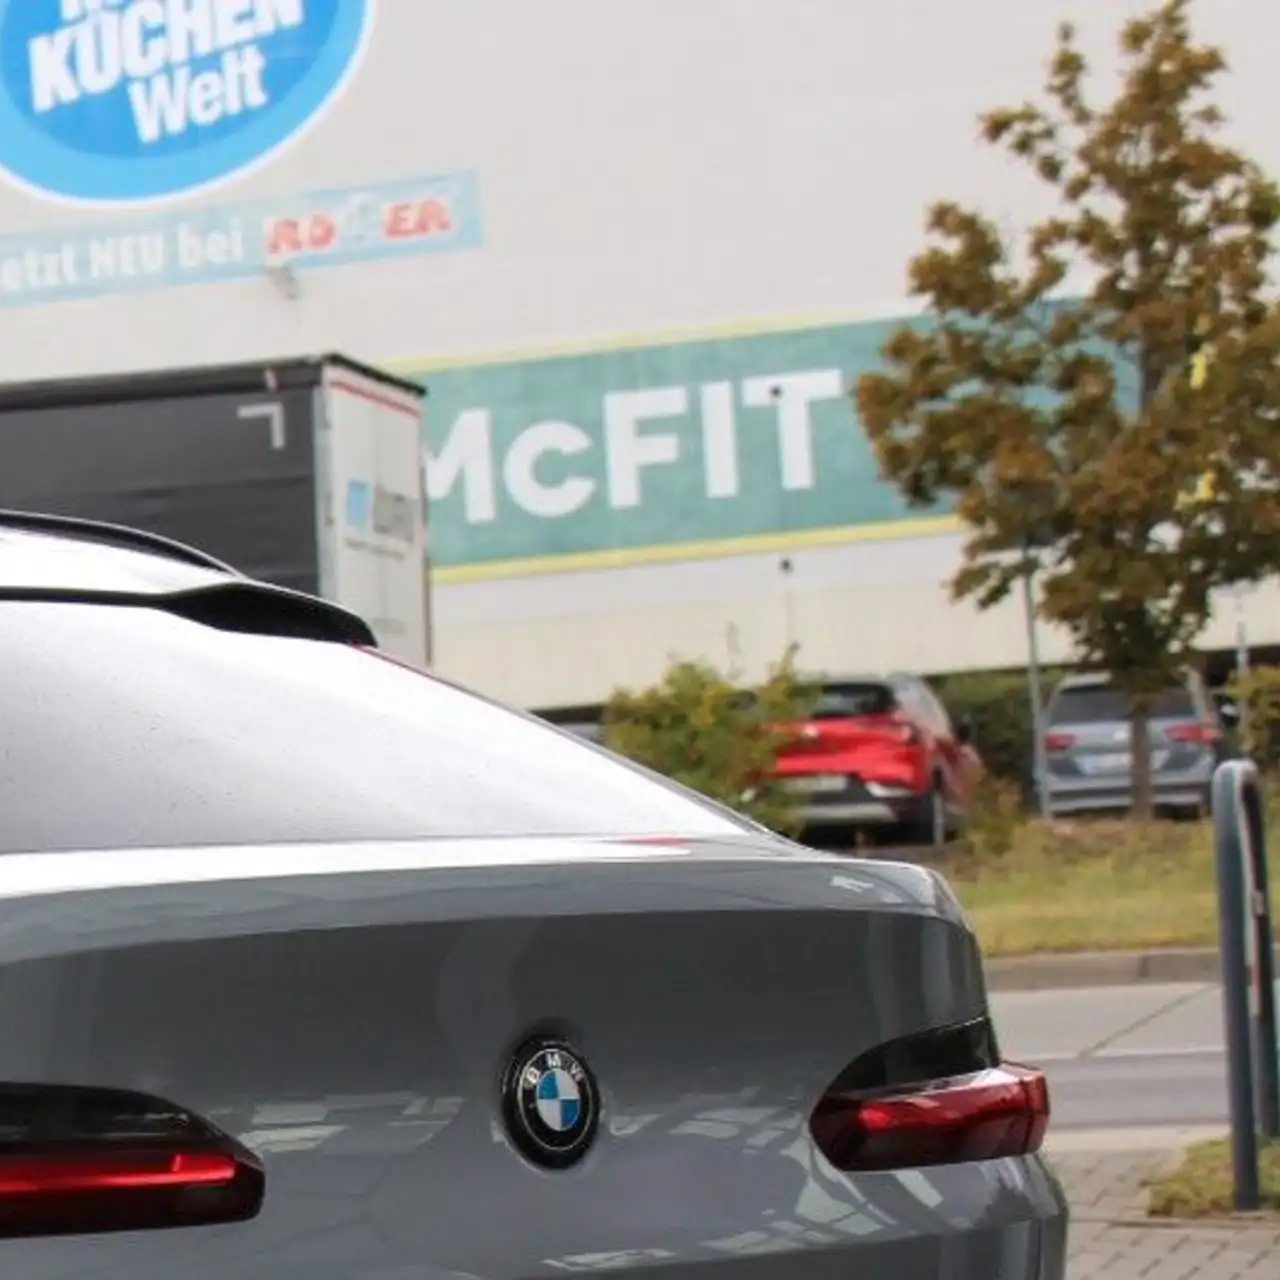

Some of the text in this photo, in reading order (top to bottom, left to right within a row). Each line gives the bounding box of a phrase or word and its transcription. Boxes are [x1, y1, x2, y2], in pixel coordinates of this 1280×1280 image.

[128, 44, 269, 143] Welt
[89, 230, 165, 278] NEU
[176, 218, 244, 267] bei
[424, 368, 843, 524] McFIT
[522, 1051, 585, 1089] BMW
